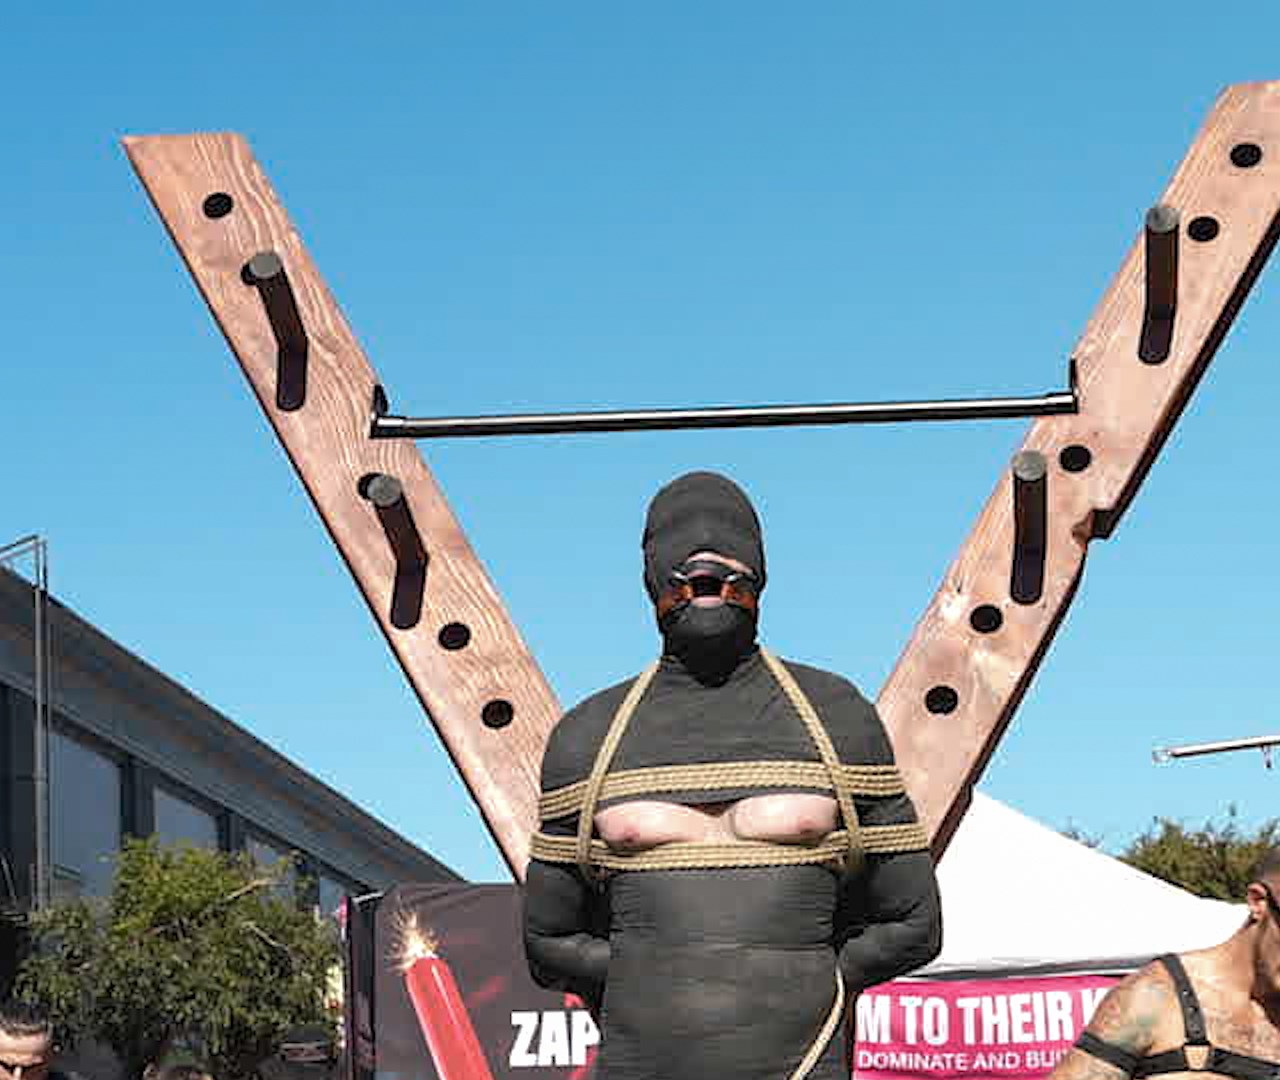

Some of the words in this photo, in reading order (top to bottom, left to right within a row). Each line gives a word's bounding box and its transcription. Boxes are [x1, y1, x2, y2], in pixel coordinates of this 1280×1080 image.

[508, 1010, 601, 1068] ZAP
[899, 995, 950, 1046] TO
[956, 990, 1075, 1046] THEIR
[857, 1050, 969, 1071] DOMINATE
[972, 1050, 1022, 1070] AND
